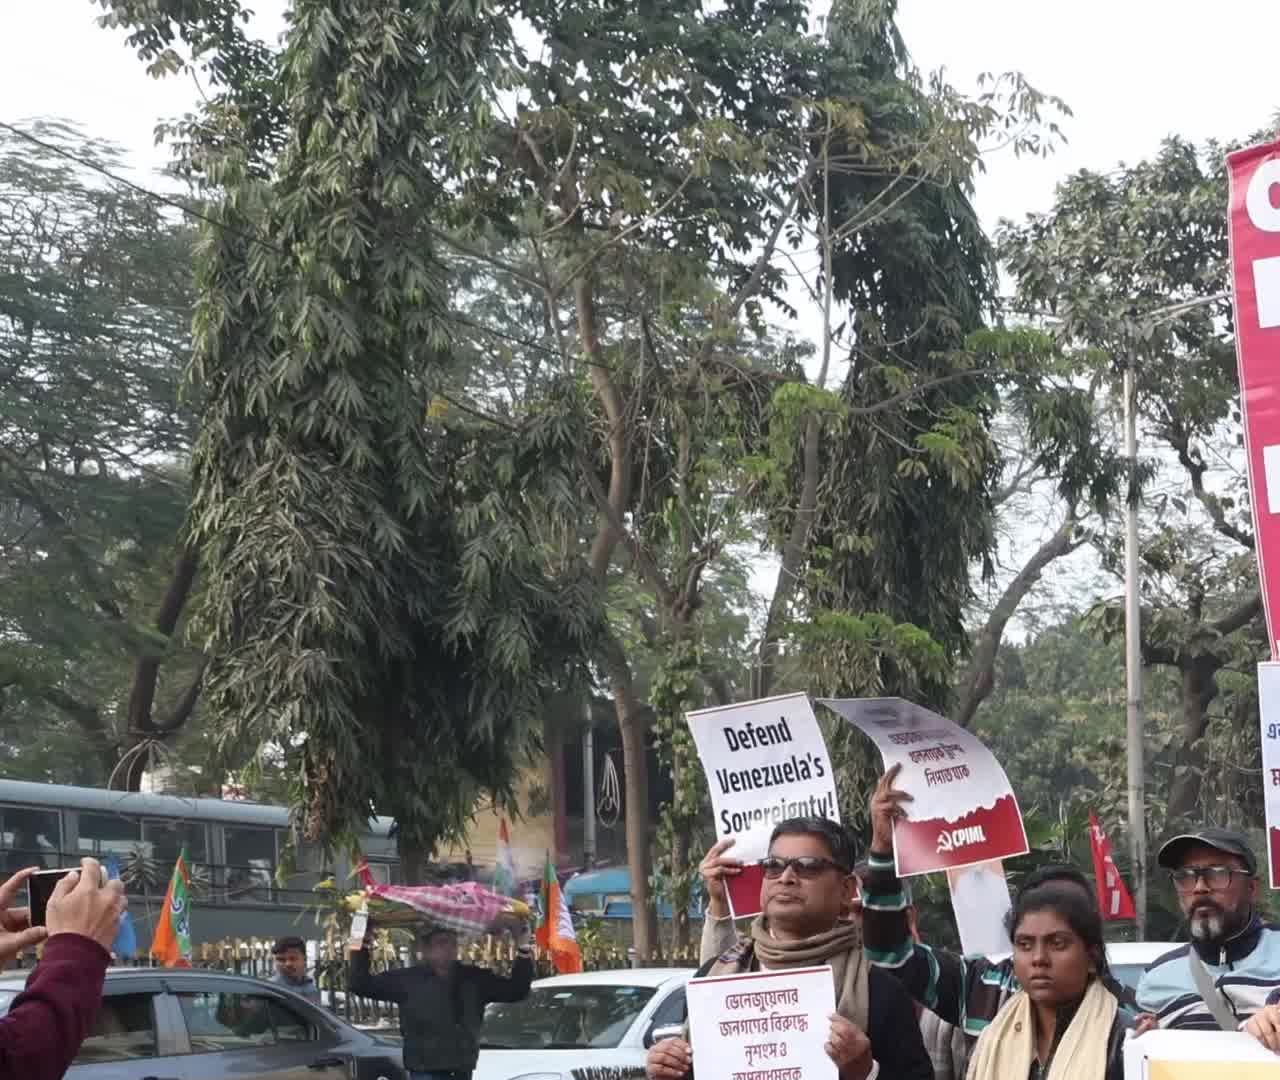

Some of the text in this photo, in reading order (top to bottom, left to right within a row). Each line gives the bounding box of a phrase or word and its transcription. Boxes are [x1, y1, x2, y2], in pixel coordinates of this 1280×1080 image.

[723, 715, 793, 753] Defend
[715, 752, 826, 796] Venezuela's
[951, 824, 986, 848] CPIML
[719, 1015, 770, 1038] জনগণের
[744, 1041, 788, 1066] নৃশংস ও
